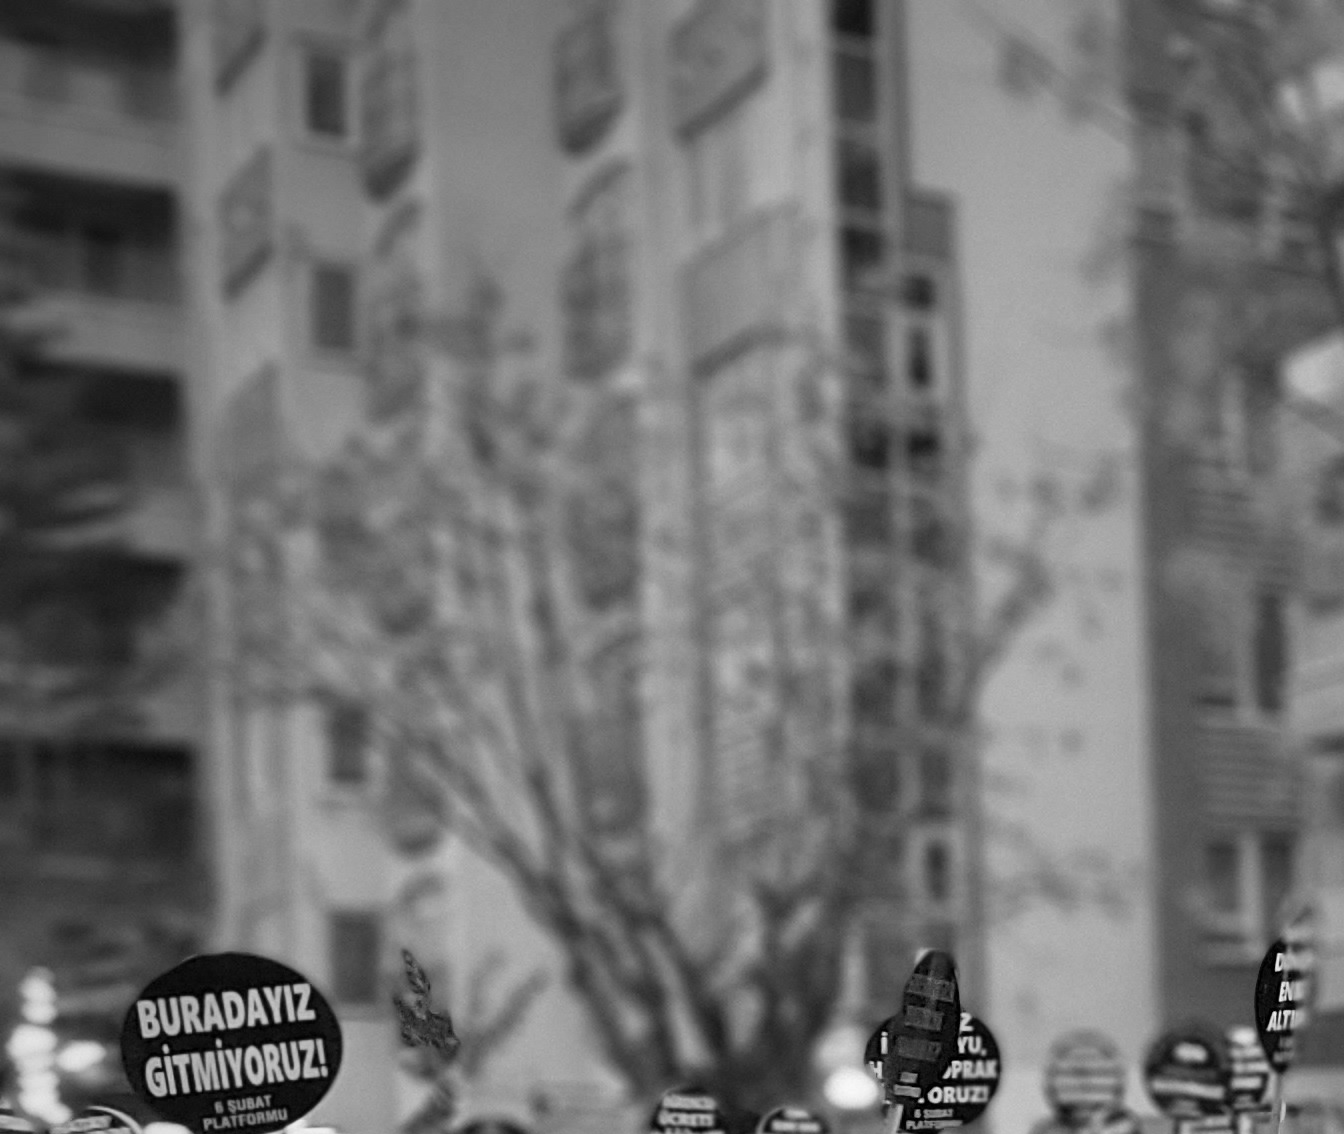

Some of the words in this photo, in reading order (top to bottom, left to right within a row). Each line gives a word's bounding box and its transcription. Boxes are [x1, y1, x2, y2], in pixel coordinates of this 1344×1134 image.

[137, 983, 316, 1039] BURADAYIZ
[145, 1038, 329, 1098] GİTMİYORUZ!
[942, 1060, 998, 1079] PRAK
[214, 1101, 224, 1114] 6
[227, 1095, 273, 1114] ŞUBAT
[203, 1108, 289, 1131] PLATFORMU
